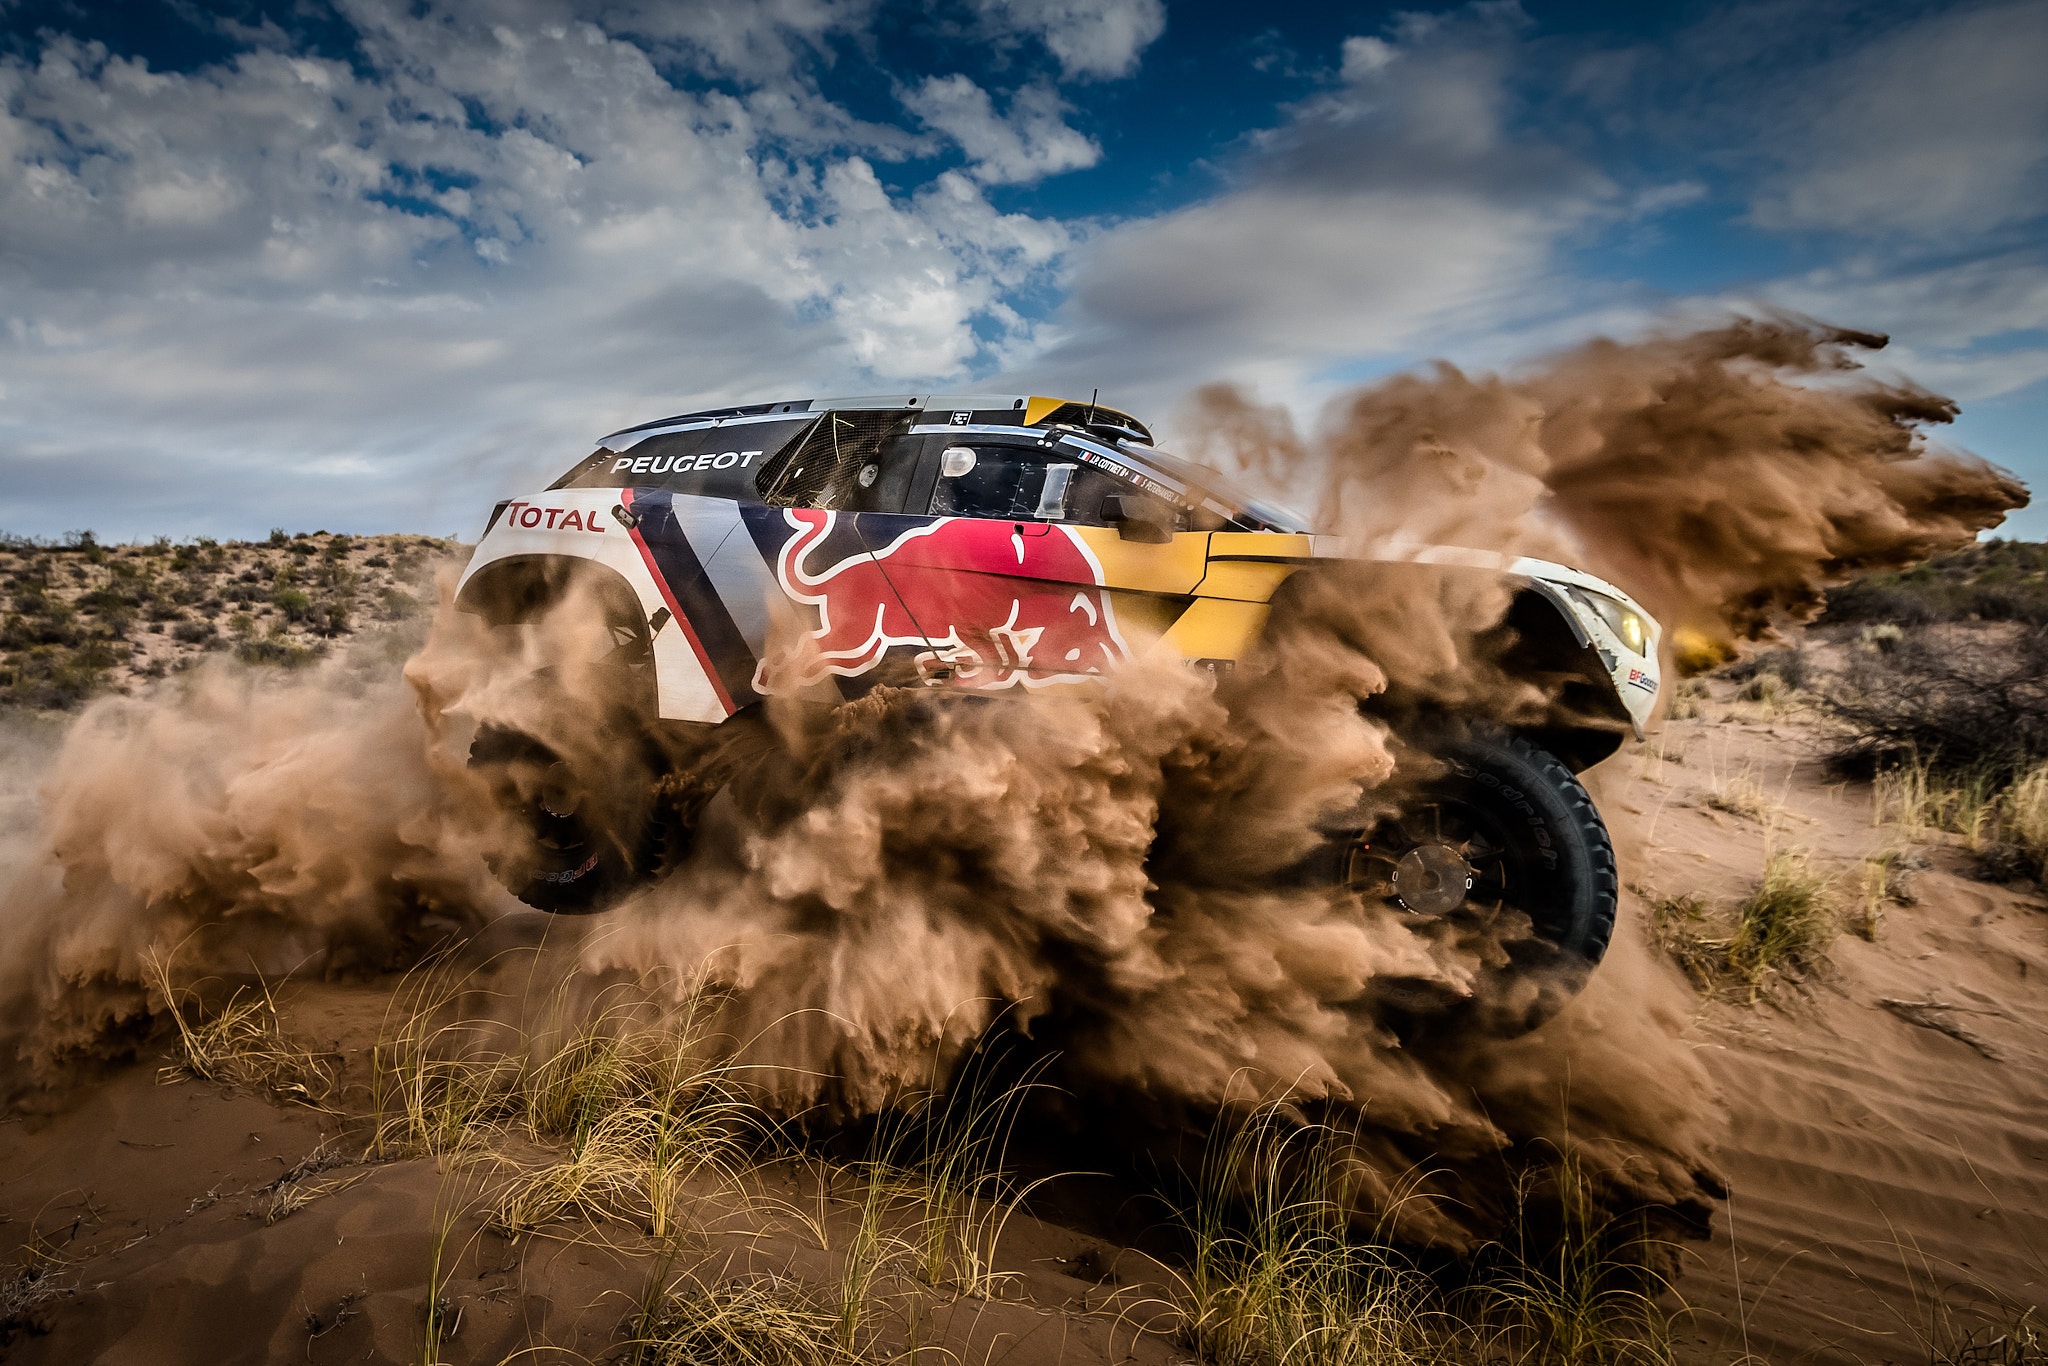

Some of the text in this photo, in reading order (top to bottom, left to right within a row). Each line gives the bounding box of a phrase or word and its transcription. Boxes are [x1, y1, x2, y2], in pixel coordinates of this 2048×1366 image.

[609, 450, 763, 475] PEUGEOT
[1098, 458, 1124, 475] COTTRET
[508, 502, 606, 533] TOTAL
